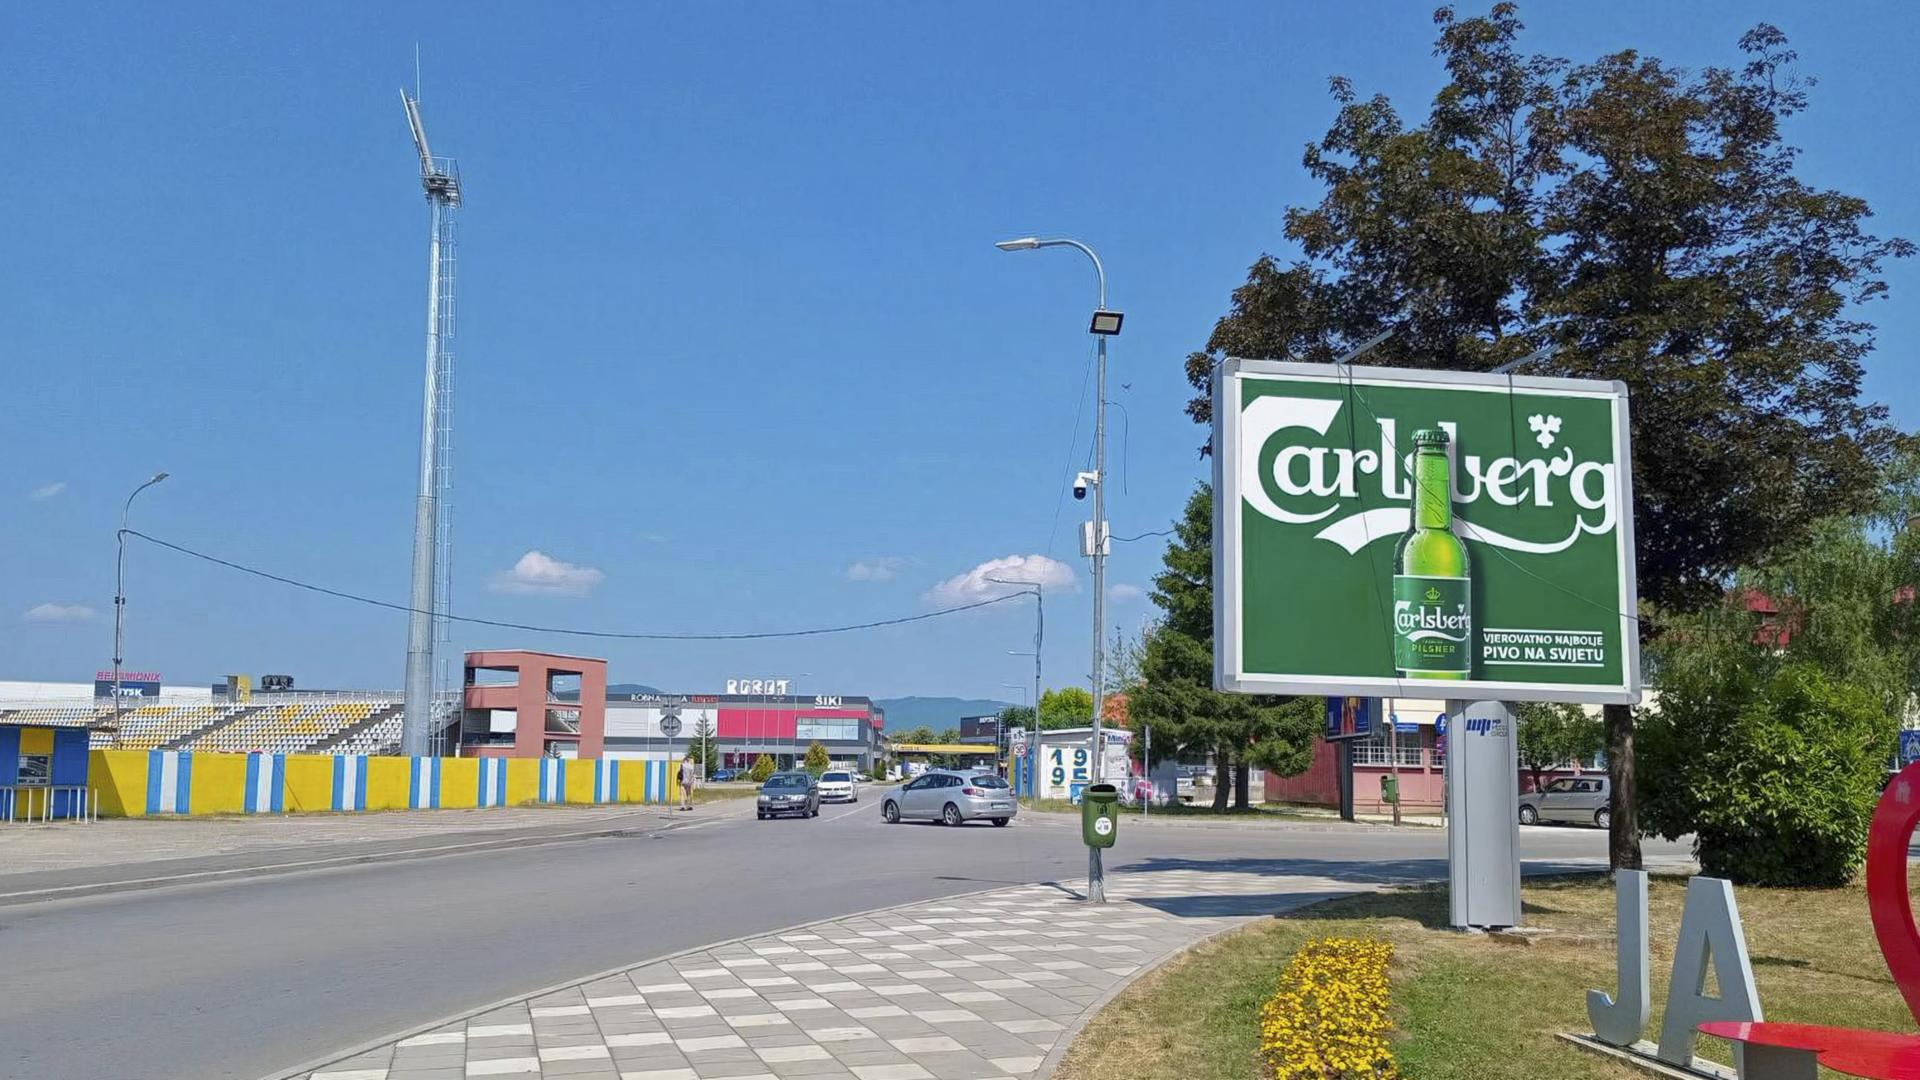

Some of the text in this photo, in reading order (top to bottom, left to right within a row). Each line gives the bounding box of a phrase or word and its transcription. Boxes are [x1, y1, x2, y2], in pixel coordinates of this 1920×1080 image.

[1241, 395, 1617, 534] Carlberg
[1483, 633, 1603, 646] VJEROVATNO NAJBOLJE
[1483, 646, 1604, 662] PIVO NA SVIJETU
[815, 695, 842, 706] ŠIKI
